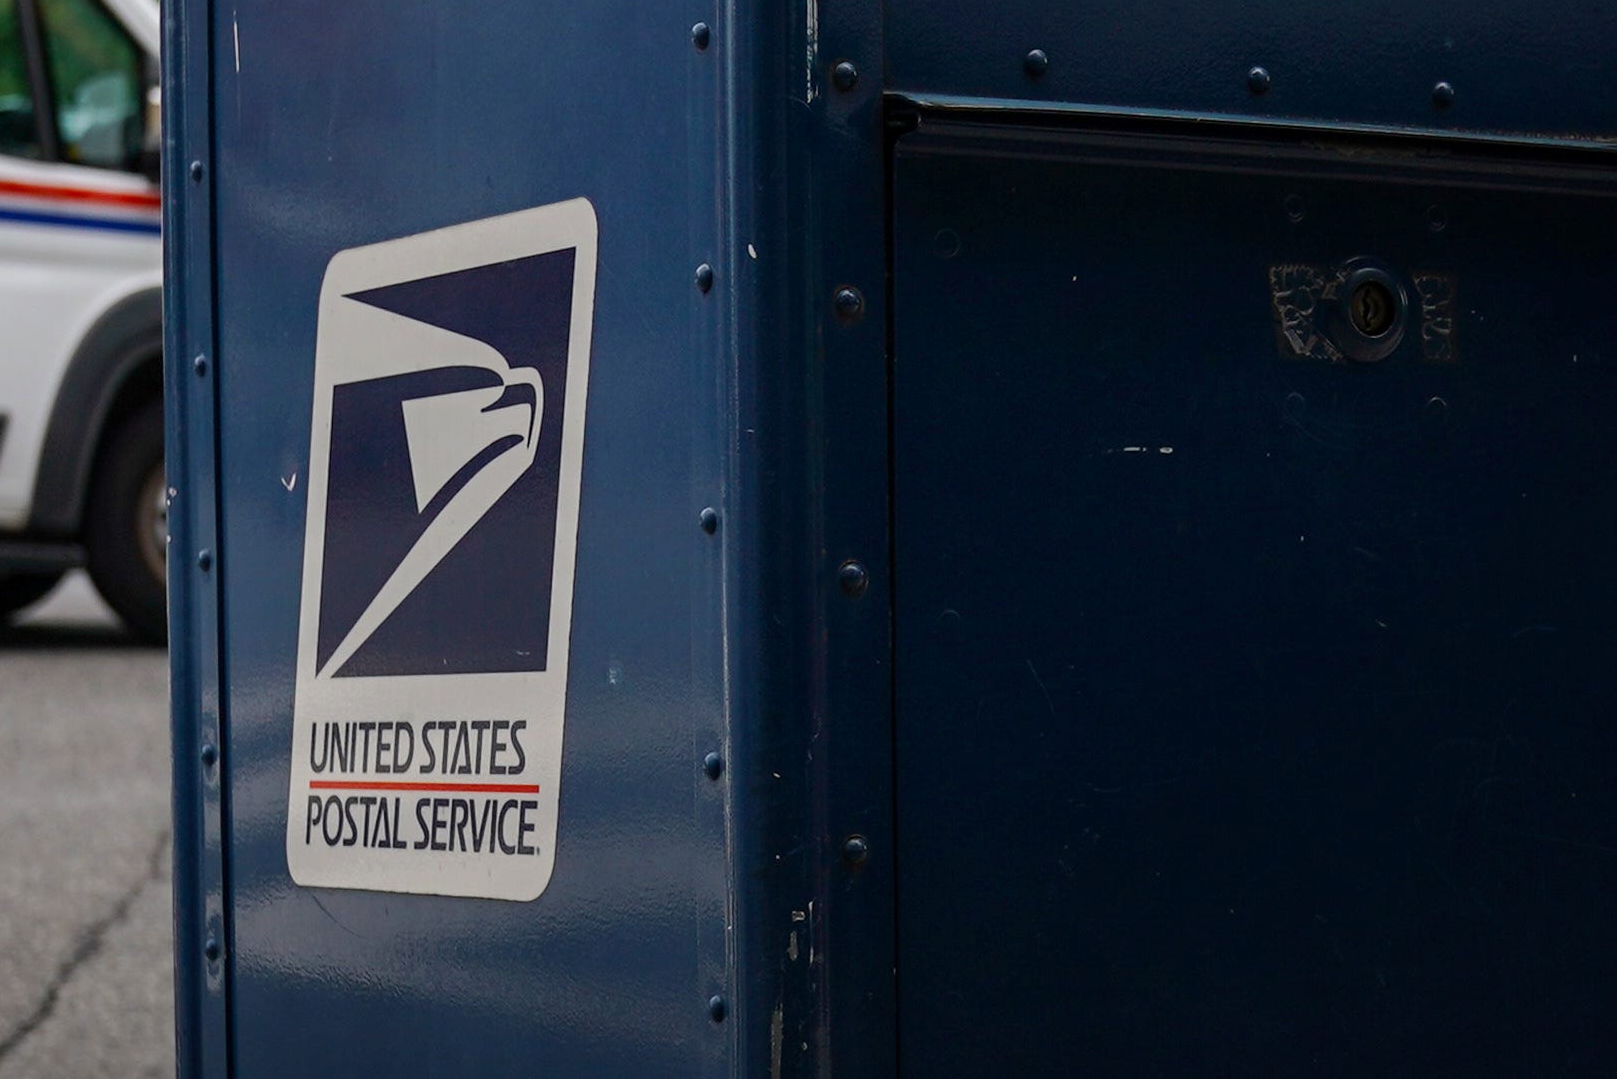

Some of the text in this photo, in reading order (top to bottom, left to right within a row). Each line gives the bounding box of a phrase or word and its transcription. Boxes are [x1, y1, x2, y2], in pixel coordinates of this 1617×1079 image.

[310, 720, 527, 775] UNITED STATES
[306, 795, 407, 849] POSTAL
